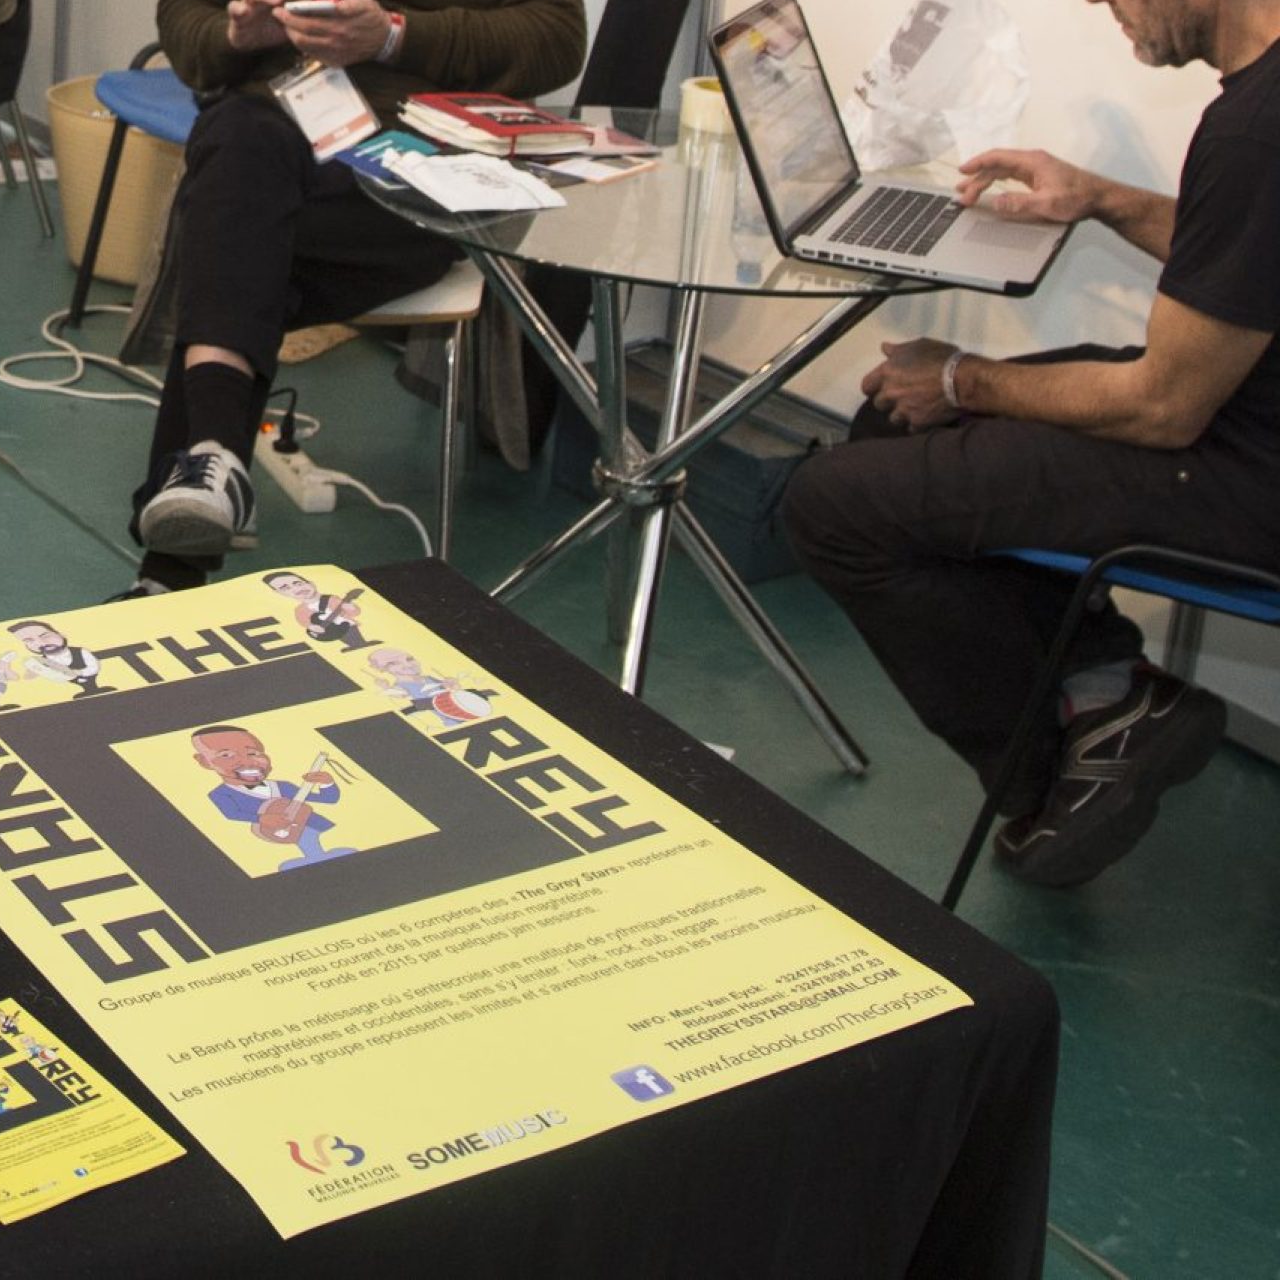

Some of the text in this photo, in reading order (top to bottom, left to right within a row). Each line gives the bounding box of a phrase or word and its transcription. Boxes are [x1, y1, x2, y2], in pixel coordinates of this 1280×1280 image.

[93, 616, 312, 684] THE
[98, 837, 712, 1011] Groupe de musique BRUXELLOIS où les 6 compères des Grey représente un
[263, 909, 521, 988] nouveau courant de la musique fusion
[307, 923, 536, 992] Fondé en 2015 par quelques jam
[167, 885, 766, 1065] Le Band prône le métissage où s'entrecroise une multitude de rythmiques traditionnelles
[169, 922, 759, 1102] Les musiciens du groupe repoussent les limites et s'aventurent dans tous les recoins
[243, 917, 719, 1063] maghrébines et sans s'y limiter reggae
[627, 983, 766, 1032] INFO: Marc Van Eyck:
[664, 967, 902, 1052] THEGREYSSTARS@GMAIL.COM
[674, 982, 948, 1084] www.facebook.com/TheGrayStars
[682, 1005, 738, 1029] Ridouan
[307, 1163, 395, 1198] FÉDÉRATION
